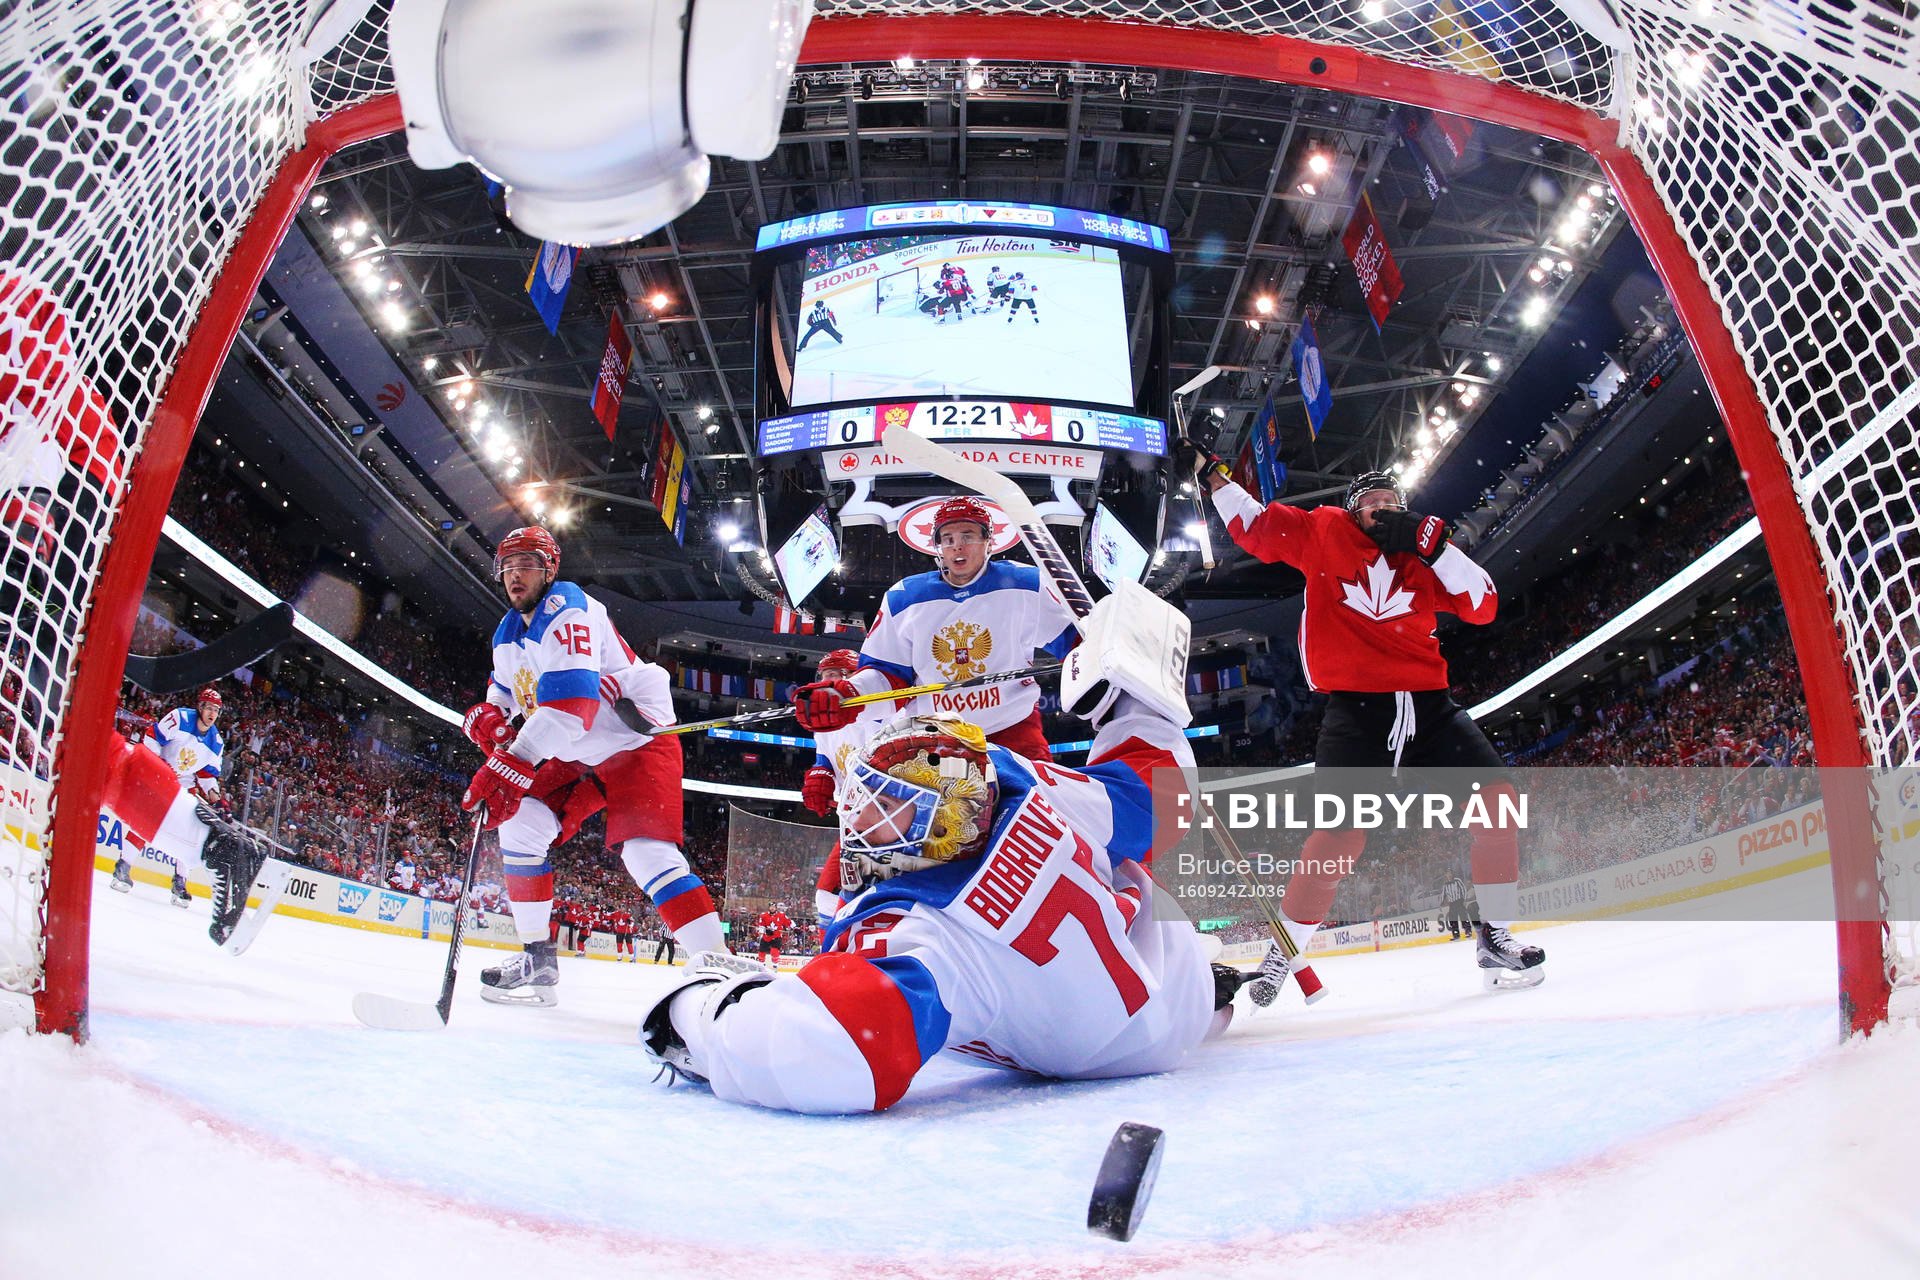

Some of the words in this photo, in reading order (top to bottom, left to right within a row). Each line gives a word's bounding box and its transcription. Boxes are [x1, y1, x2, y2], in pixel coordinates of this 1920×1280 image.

[894, 244, 939, 259] SPORTCHEK
[956, 240, 980, 255] Tim
[981, 237, 1035, 252] Hortons
[1352, 224, 1373, 267] WORLD
[1356, 252, 1369, 277] CUP
[1359, 241, 1383, 289] HOCKEY
[814, 262, 880, 293] HONDA
[1362, 270, 1378, 299] 2016
[865, 407, 871, 415] 2
[926, 405, 1002, 426] 12:21
[766, 422, 804, 433] MARCHENKO
[841, 420, 858, 442] 0
[944, 427, 972, 436] PER
[1067, 420, 1084, 442] 0
[1099, 425, 1125, 434] CROSBY
[1099, 432, 1134, 442] MARCHAND
[960, 451, 1000, 463] ADA
[1008, 451, 1085, 468] CENTRE
[1419, 516, 1442, 549] UER
[553, 622, 592, 657] 42
[932, 686, 1001, 713] РОССИЯ
[753, 732, 760, 742] 3
[486, 756, 534, 790] WARRI
[809, 769, 834, 777] BAU
[96, 814, 123, 850] SA
[1738, 819, 1798, 866] pizza
[964, 792, 1067, 931] BOBROVS
[1613, 871, 1634, 891] AIR
[1636, 857, 1695, 887] CANADA
[339, 887, 364, 909] SAP
[380, 896, 402, 917] SAP
[1518, 879, 1598, 917] SAMSUNG
[494, 922, 518, 937] HOCK
[1334, 931, 1350, 945] VISA
[1383, 917, 1430, 938] GATORADE
